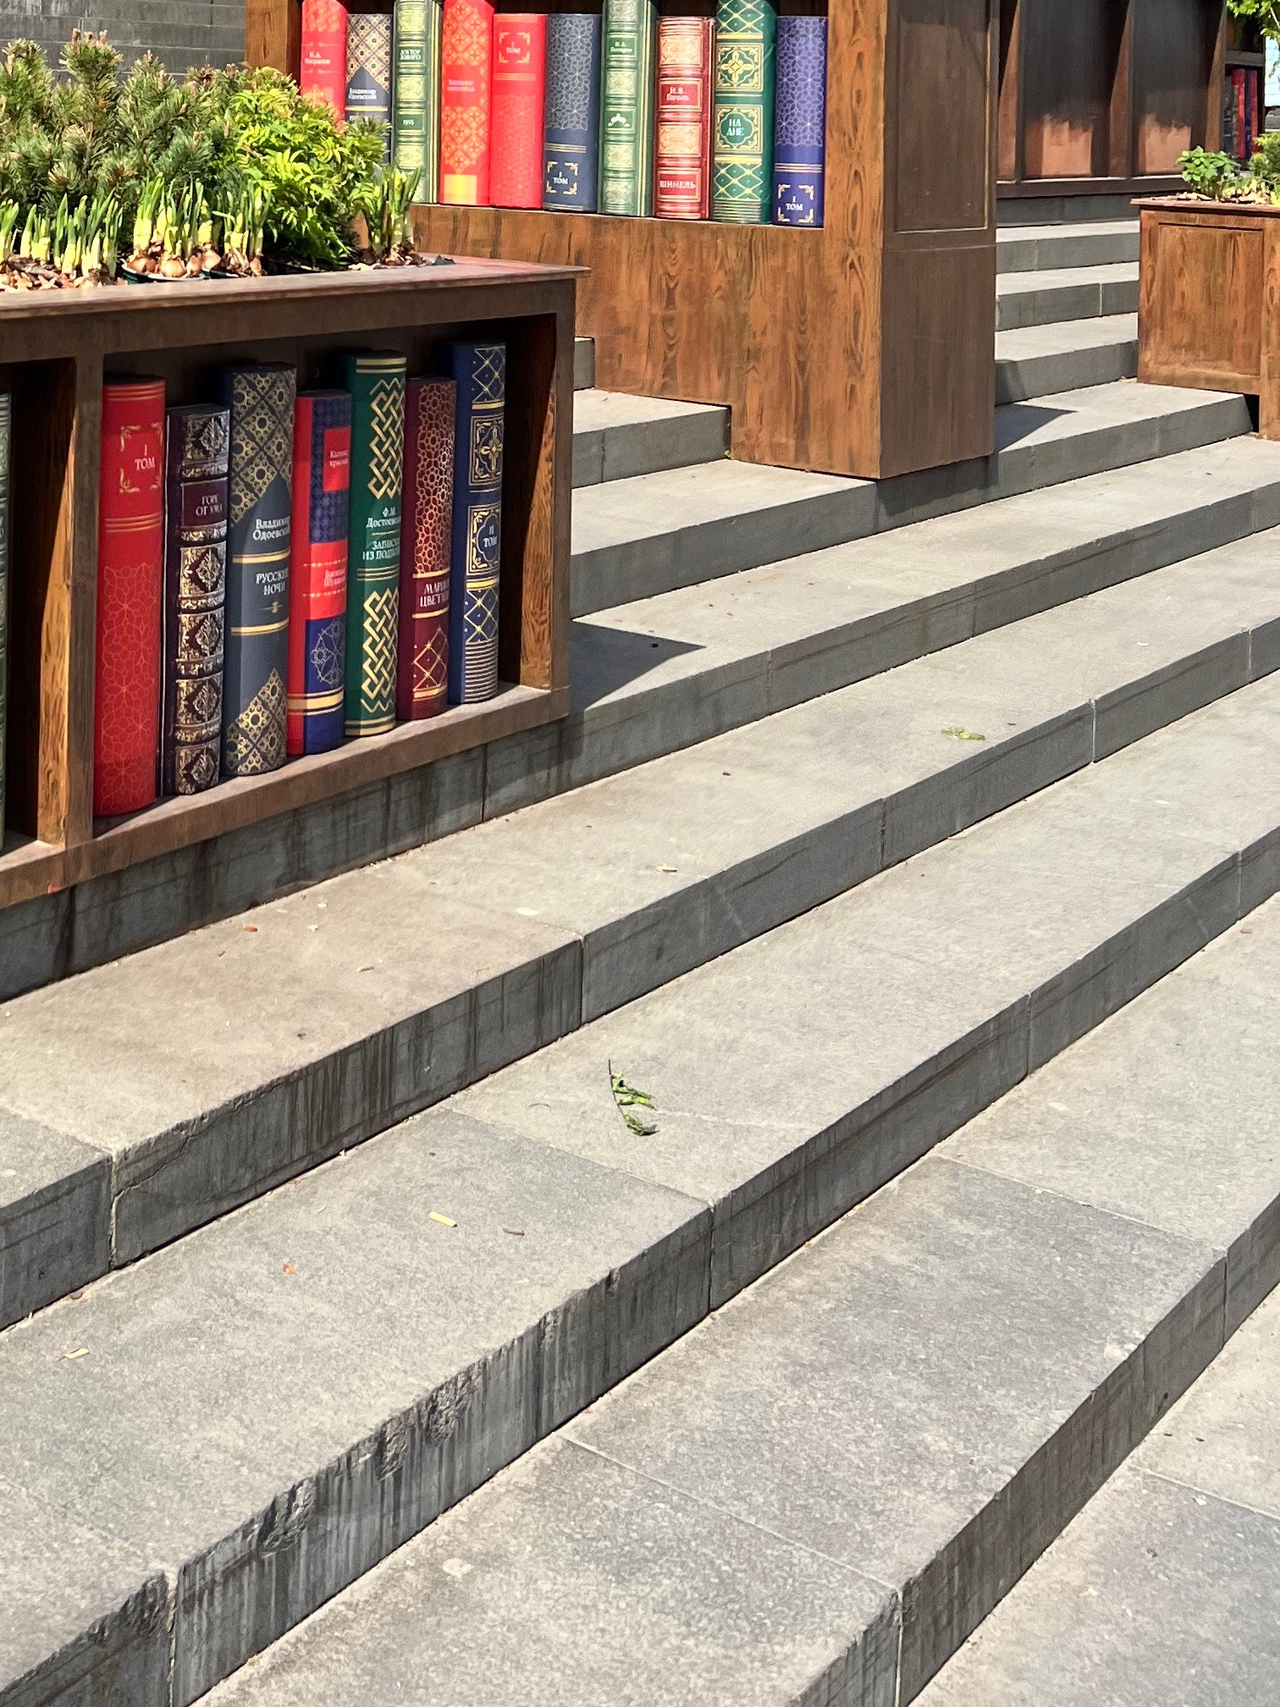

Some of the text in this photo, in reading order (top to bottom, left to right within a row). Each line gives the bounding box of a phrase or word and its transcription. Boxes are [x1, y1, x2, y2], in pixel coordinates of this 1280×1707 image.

[726, 127, 745, 136] ДНЕ
[660, 180, 696, 189] ШИНЕЛЬ
[134, 456, 156, 471] ТОМ
[483, 536, 498, 548] ТОМ
[362, 551, 375, 560] ИЗ
[263, 581, 286, 596] НОЧИ
